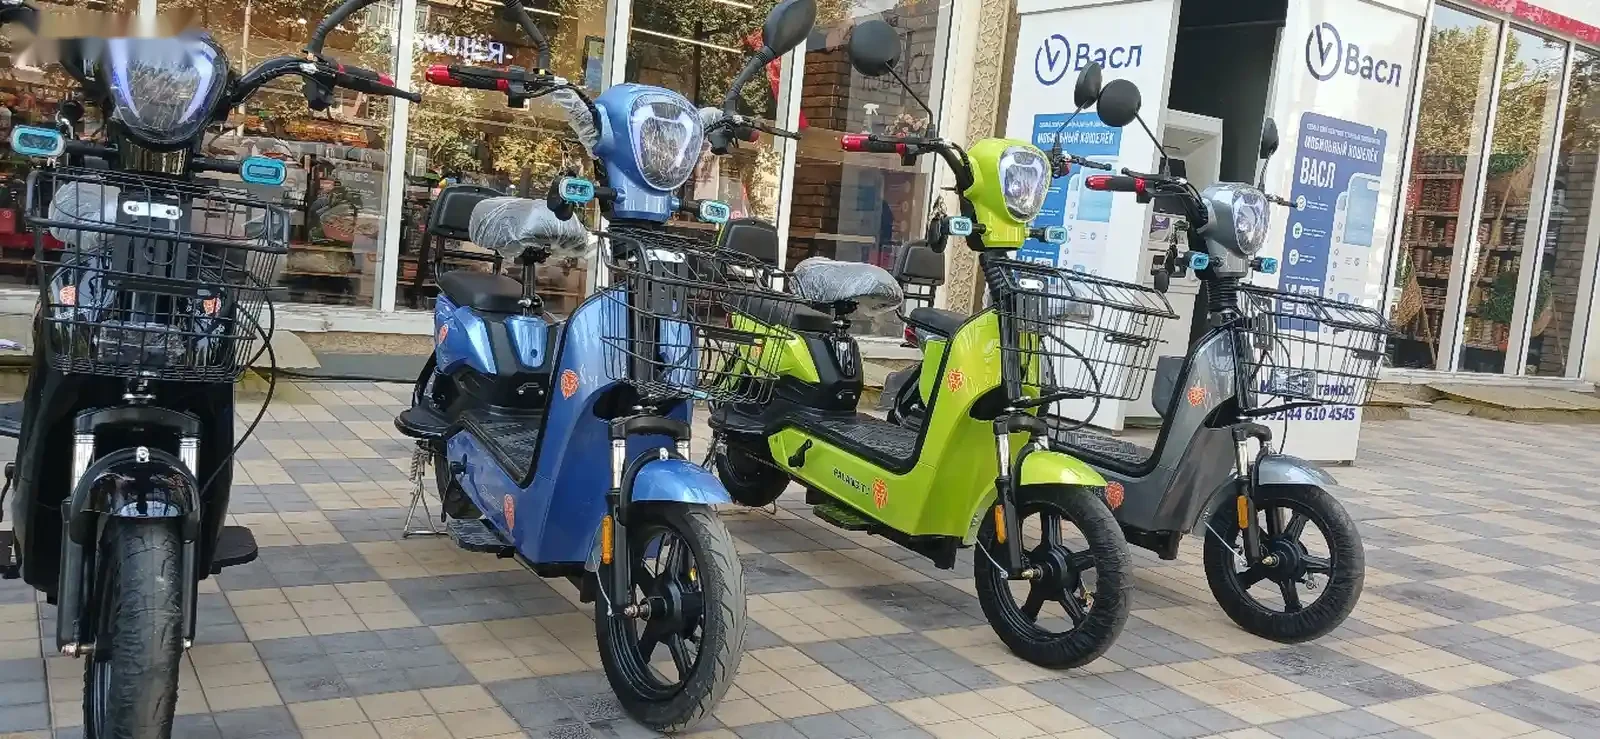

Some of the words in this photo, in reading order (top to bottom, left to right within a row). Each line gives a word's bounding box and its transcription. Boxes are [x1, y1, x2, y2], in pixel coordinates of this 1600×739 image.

[1074, 42, 1143, 72] Васл
[1344, 42, 1402, 88] Васл
[1304, 134, 1348, 156] МОБИЛЬНЫЙ
[1299, 156, 1336, 189] ВАСЛ
[1287, 408, 1302, 421] 44
[1305, 407, 1327, 421] 610
[1328, 407, 1356, 421] 4545
